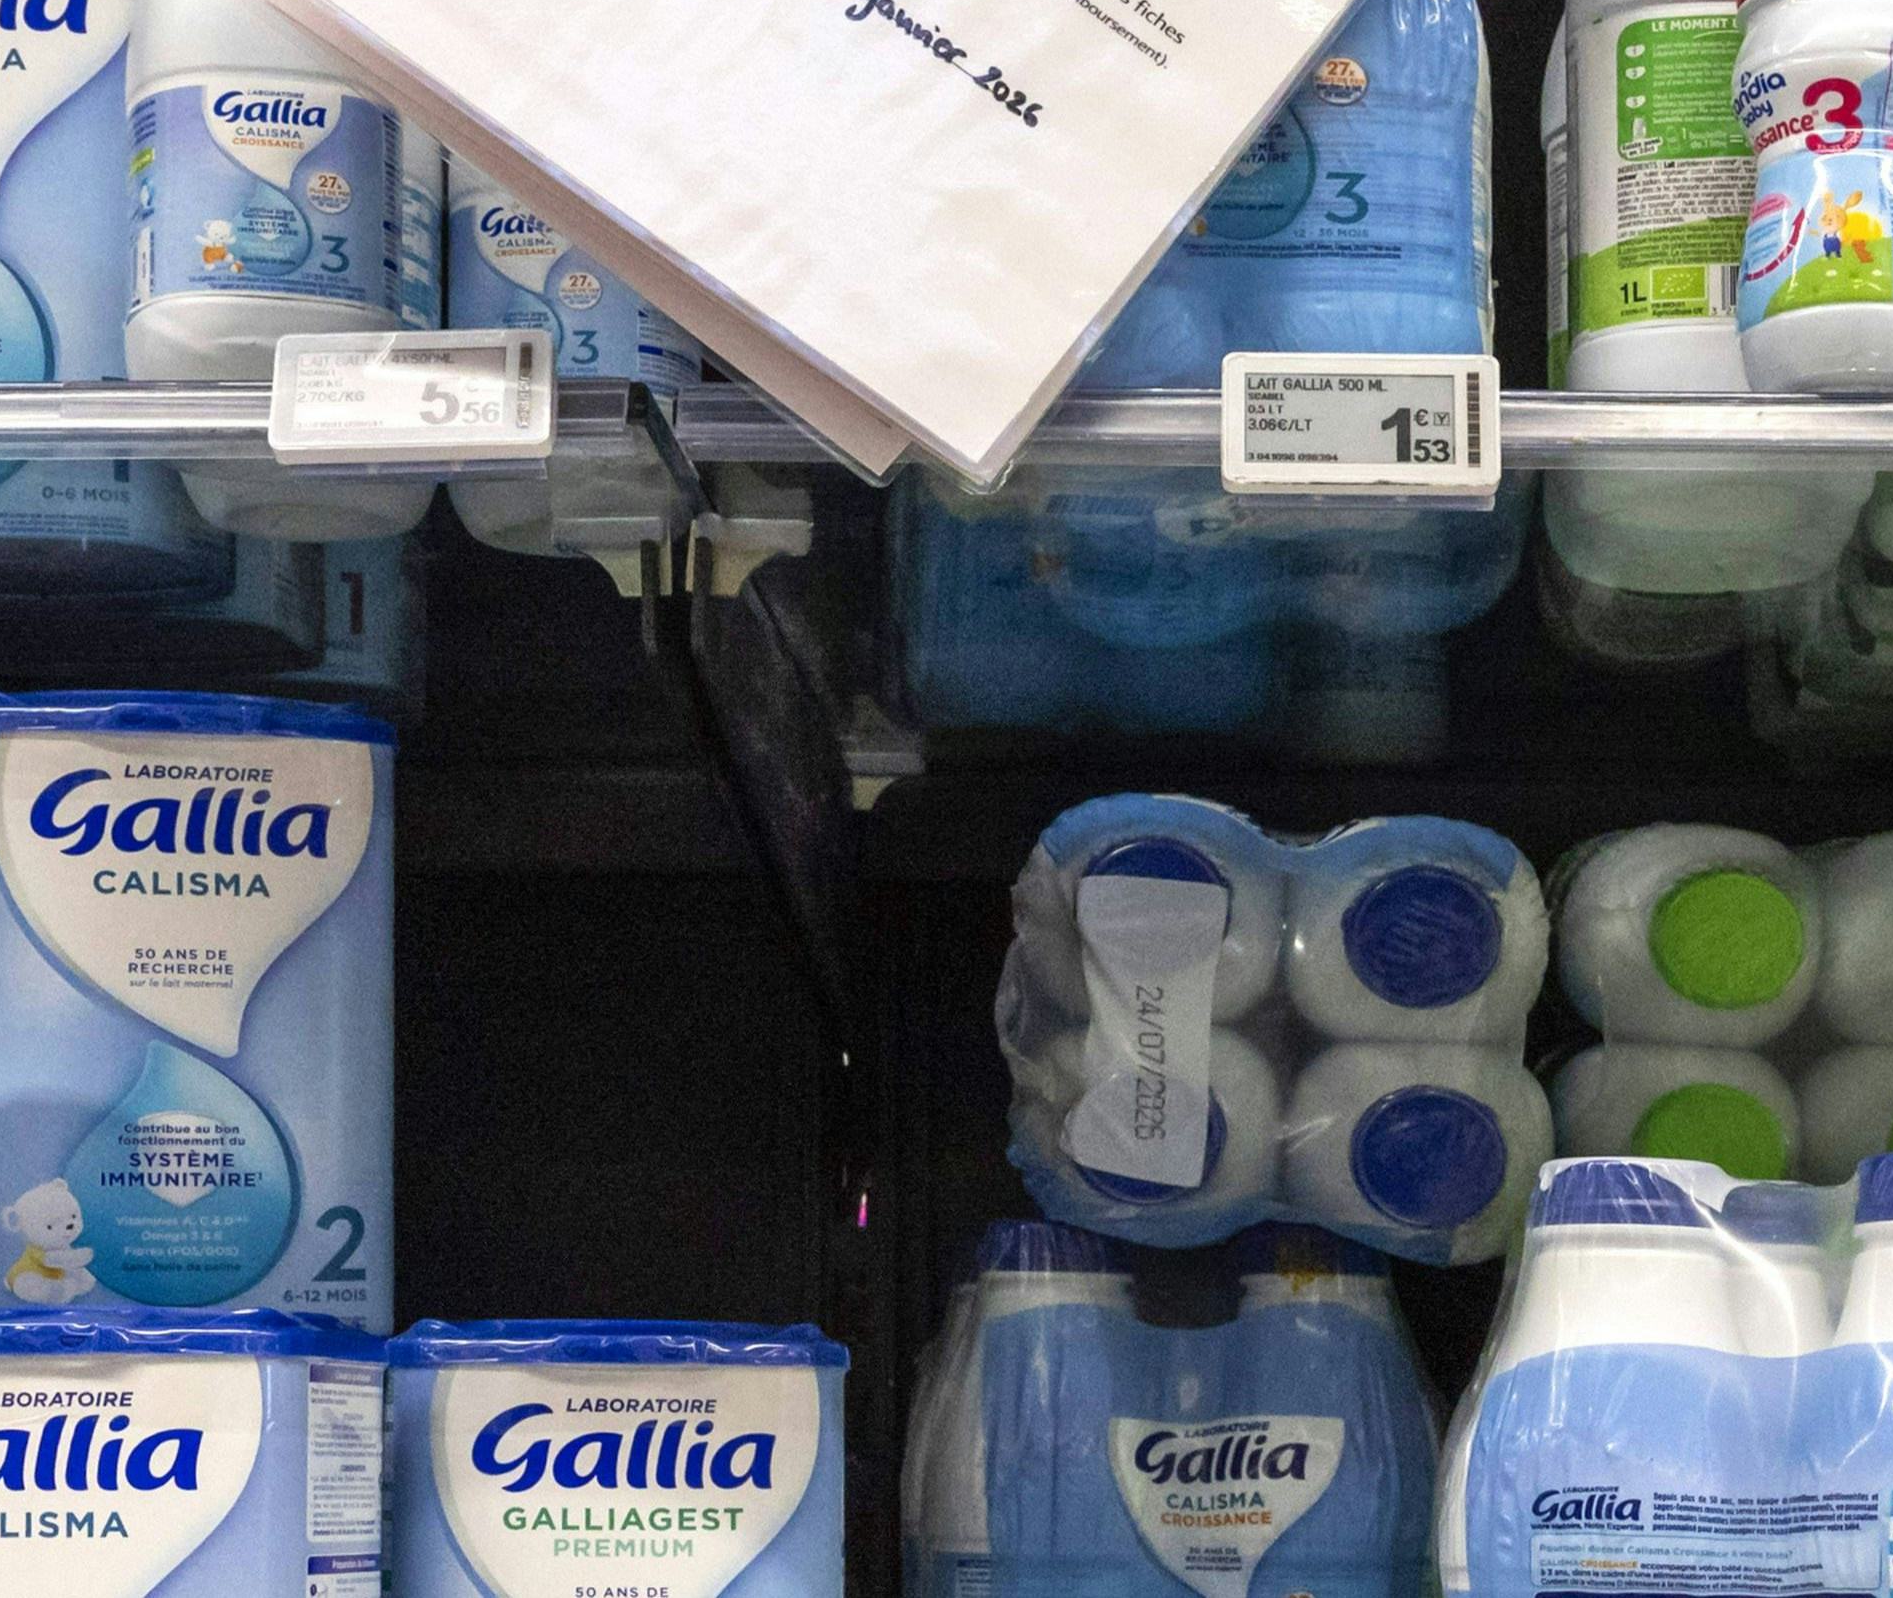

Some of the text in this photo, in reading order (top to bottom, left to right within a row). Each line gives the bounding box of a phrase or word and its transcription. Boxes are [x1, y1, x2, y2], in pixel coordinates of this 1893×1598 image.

[970, 64, 1044, 128] 2026
[1619, 282, 1647, 304] 1L
[1248, 378, 1386, 392] LAIT GALLIA 500 ML
[418, 380, 501, 424] 5 56
[1248, 419, 1312, 432] 3.06€/LT
[1381, 407, 1450, 462] 1 € 53
[1133, 984, 1169, 1141] 24/07/2026
[129, 1149, 235, 1169] SYSTÈME
[471, 1403, 776, 1493] Gallia
[503, 1507, 744, 1532] GALLIAGEST
[553, 1539, 695, 1559] PREMIUM
